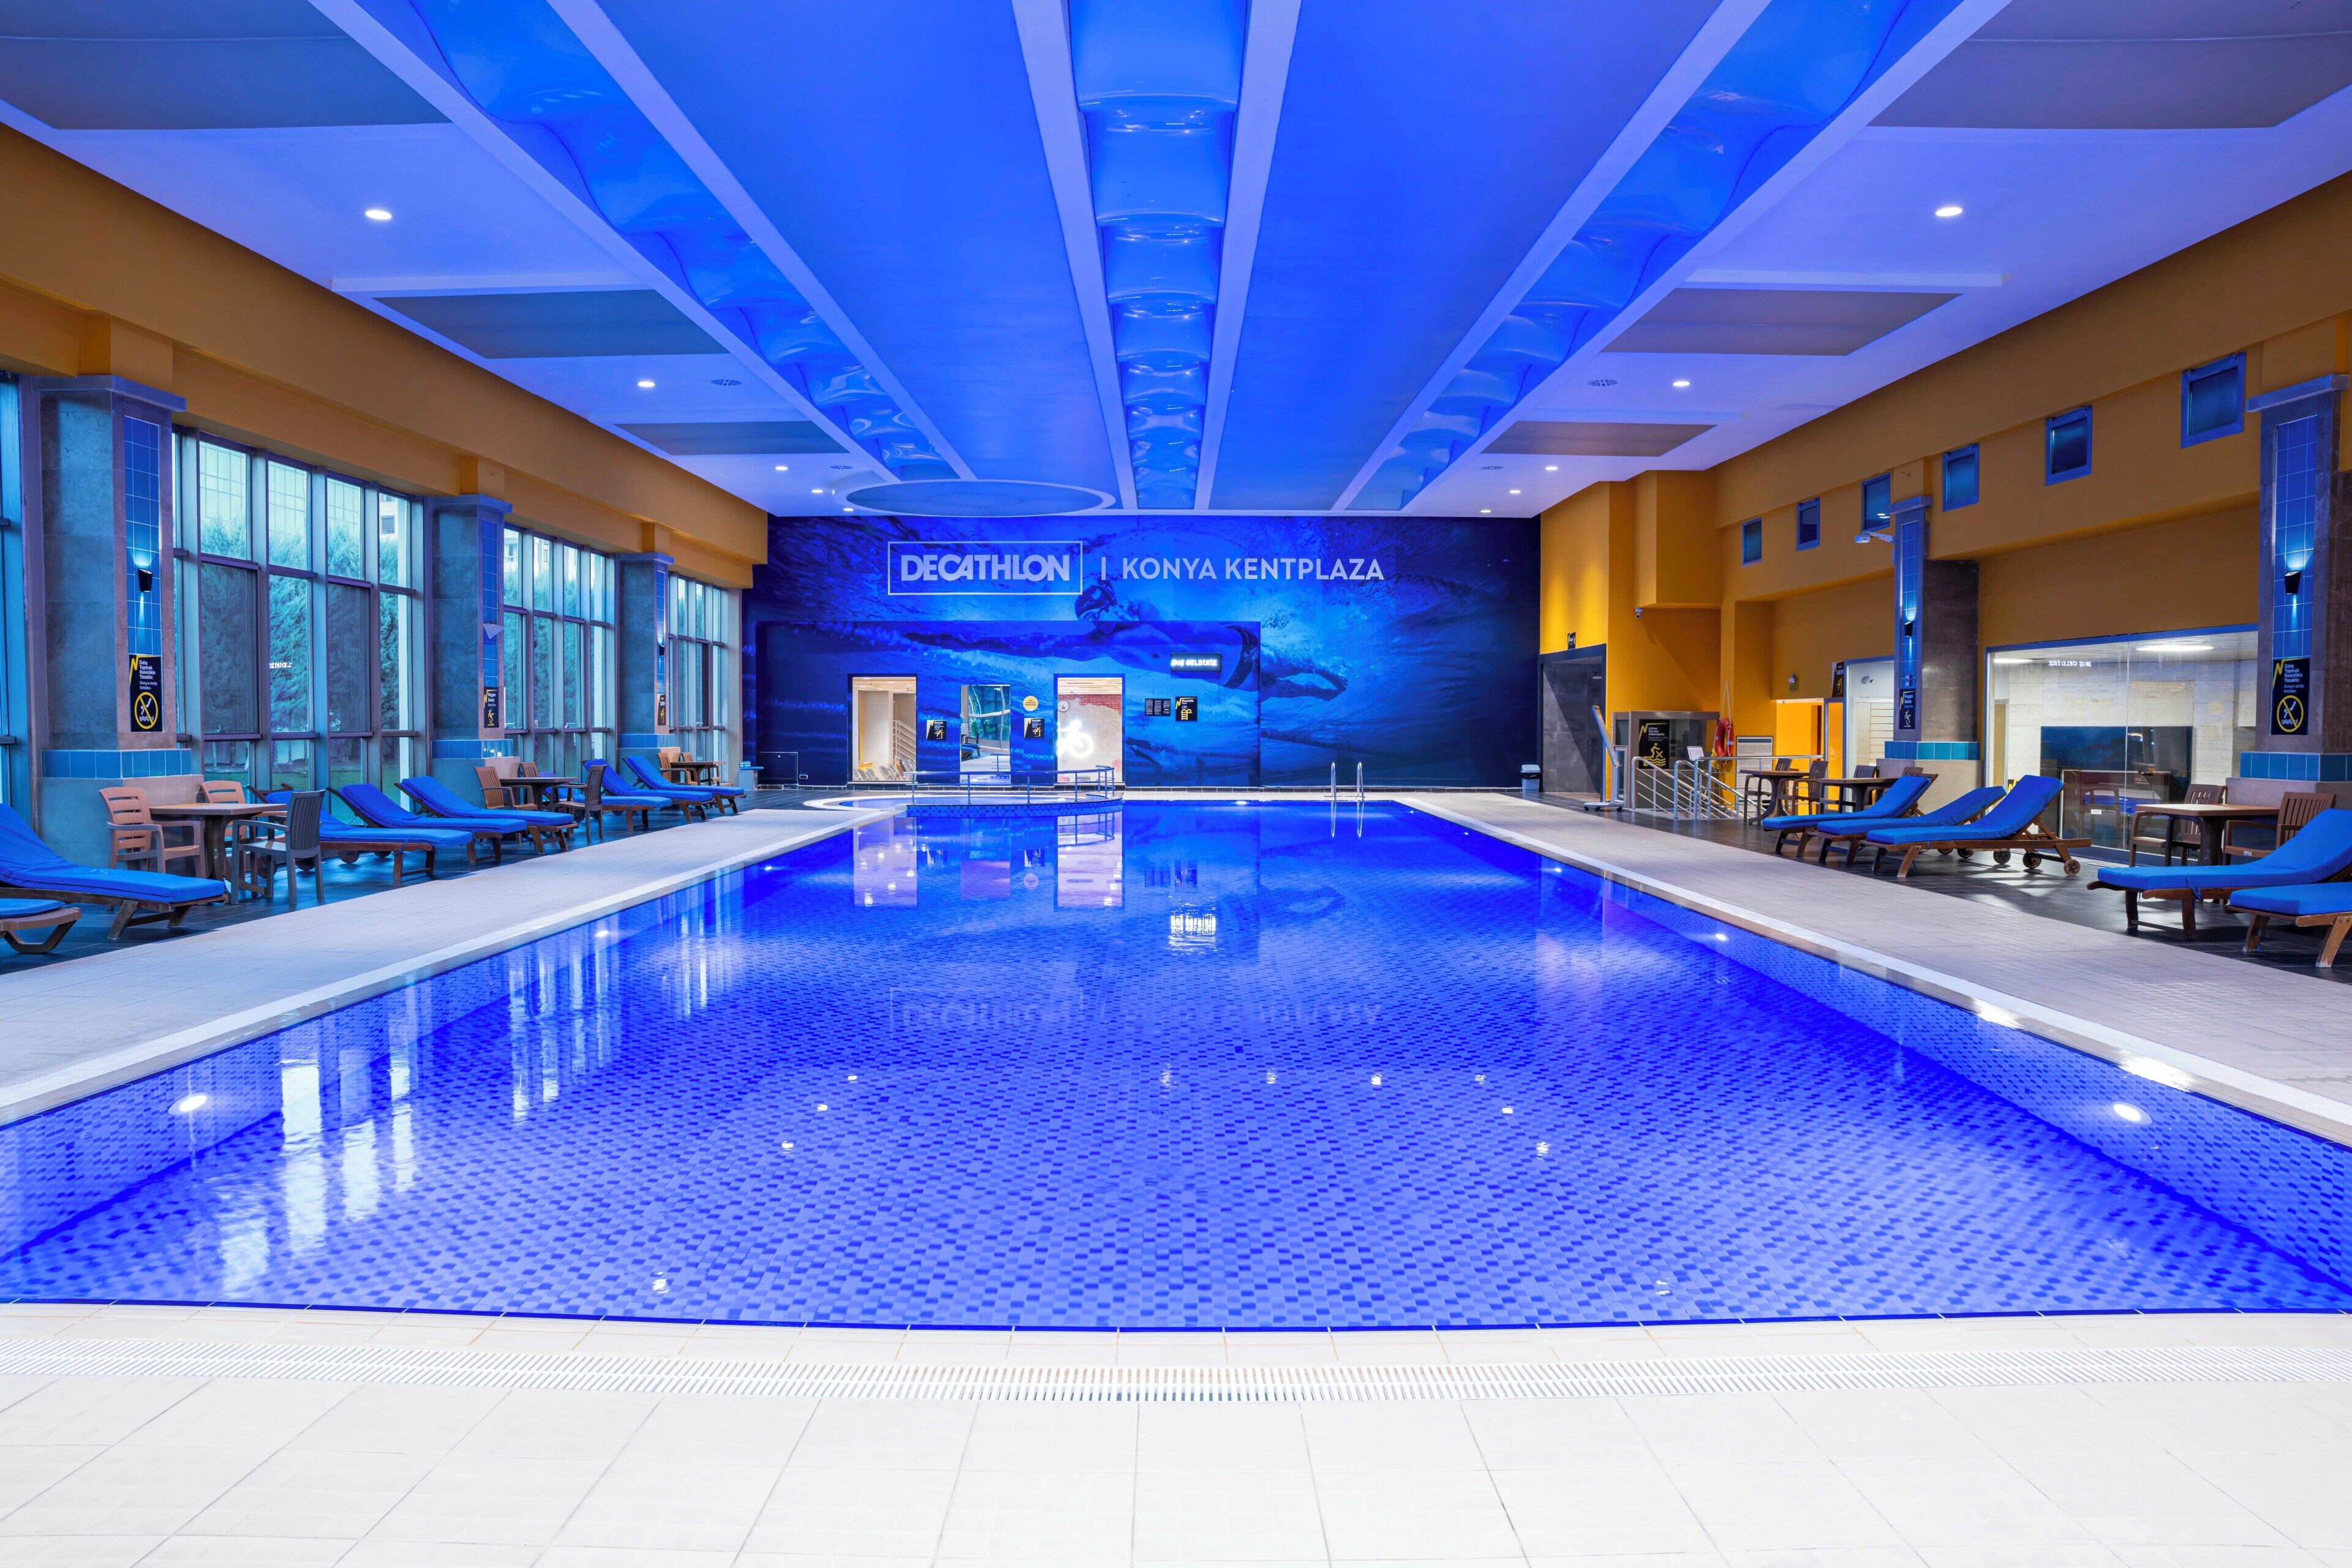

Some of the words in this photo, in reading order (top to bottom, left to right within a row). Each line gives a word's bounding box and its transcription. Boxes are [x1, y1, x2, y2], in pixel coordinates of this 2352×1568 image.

[901, 554, 1070, 582] DECATHLON
[1123, 557, 1217, 580] KONYA
[1225, 558, 1385, 581] KENTPLAZA
